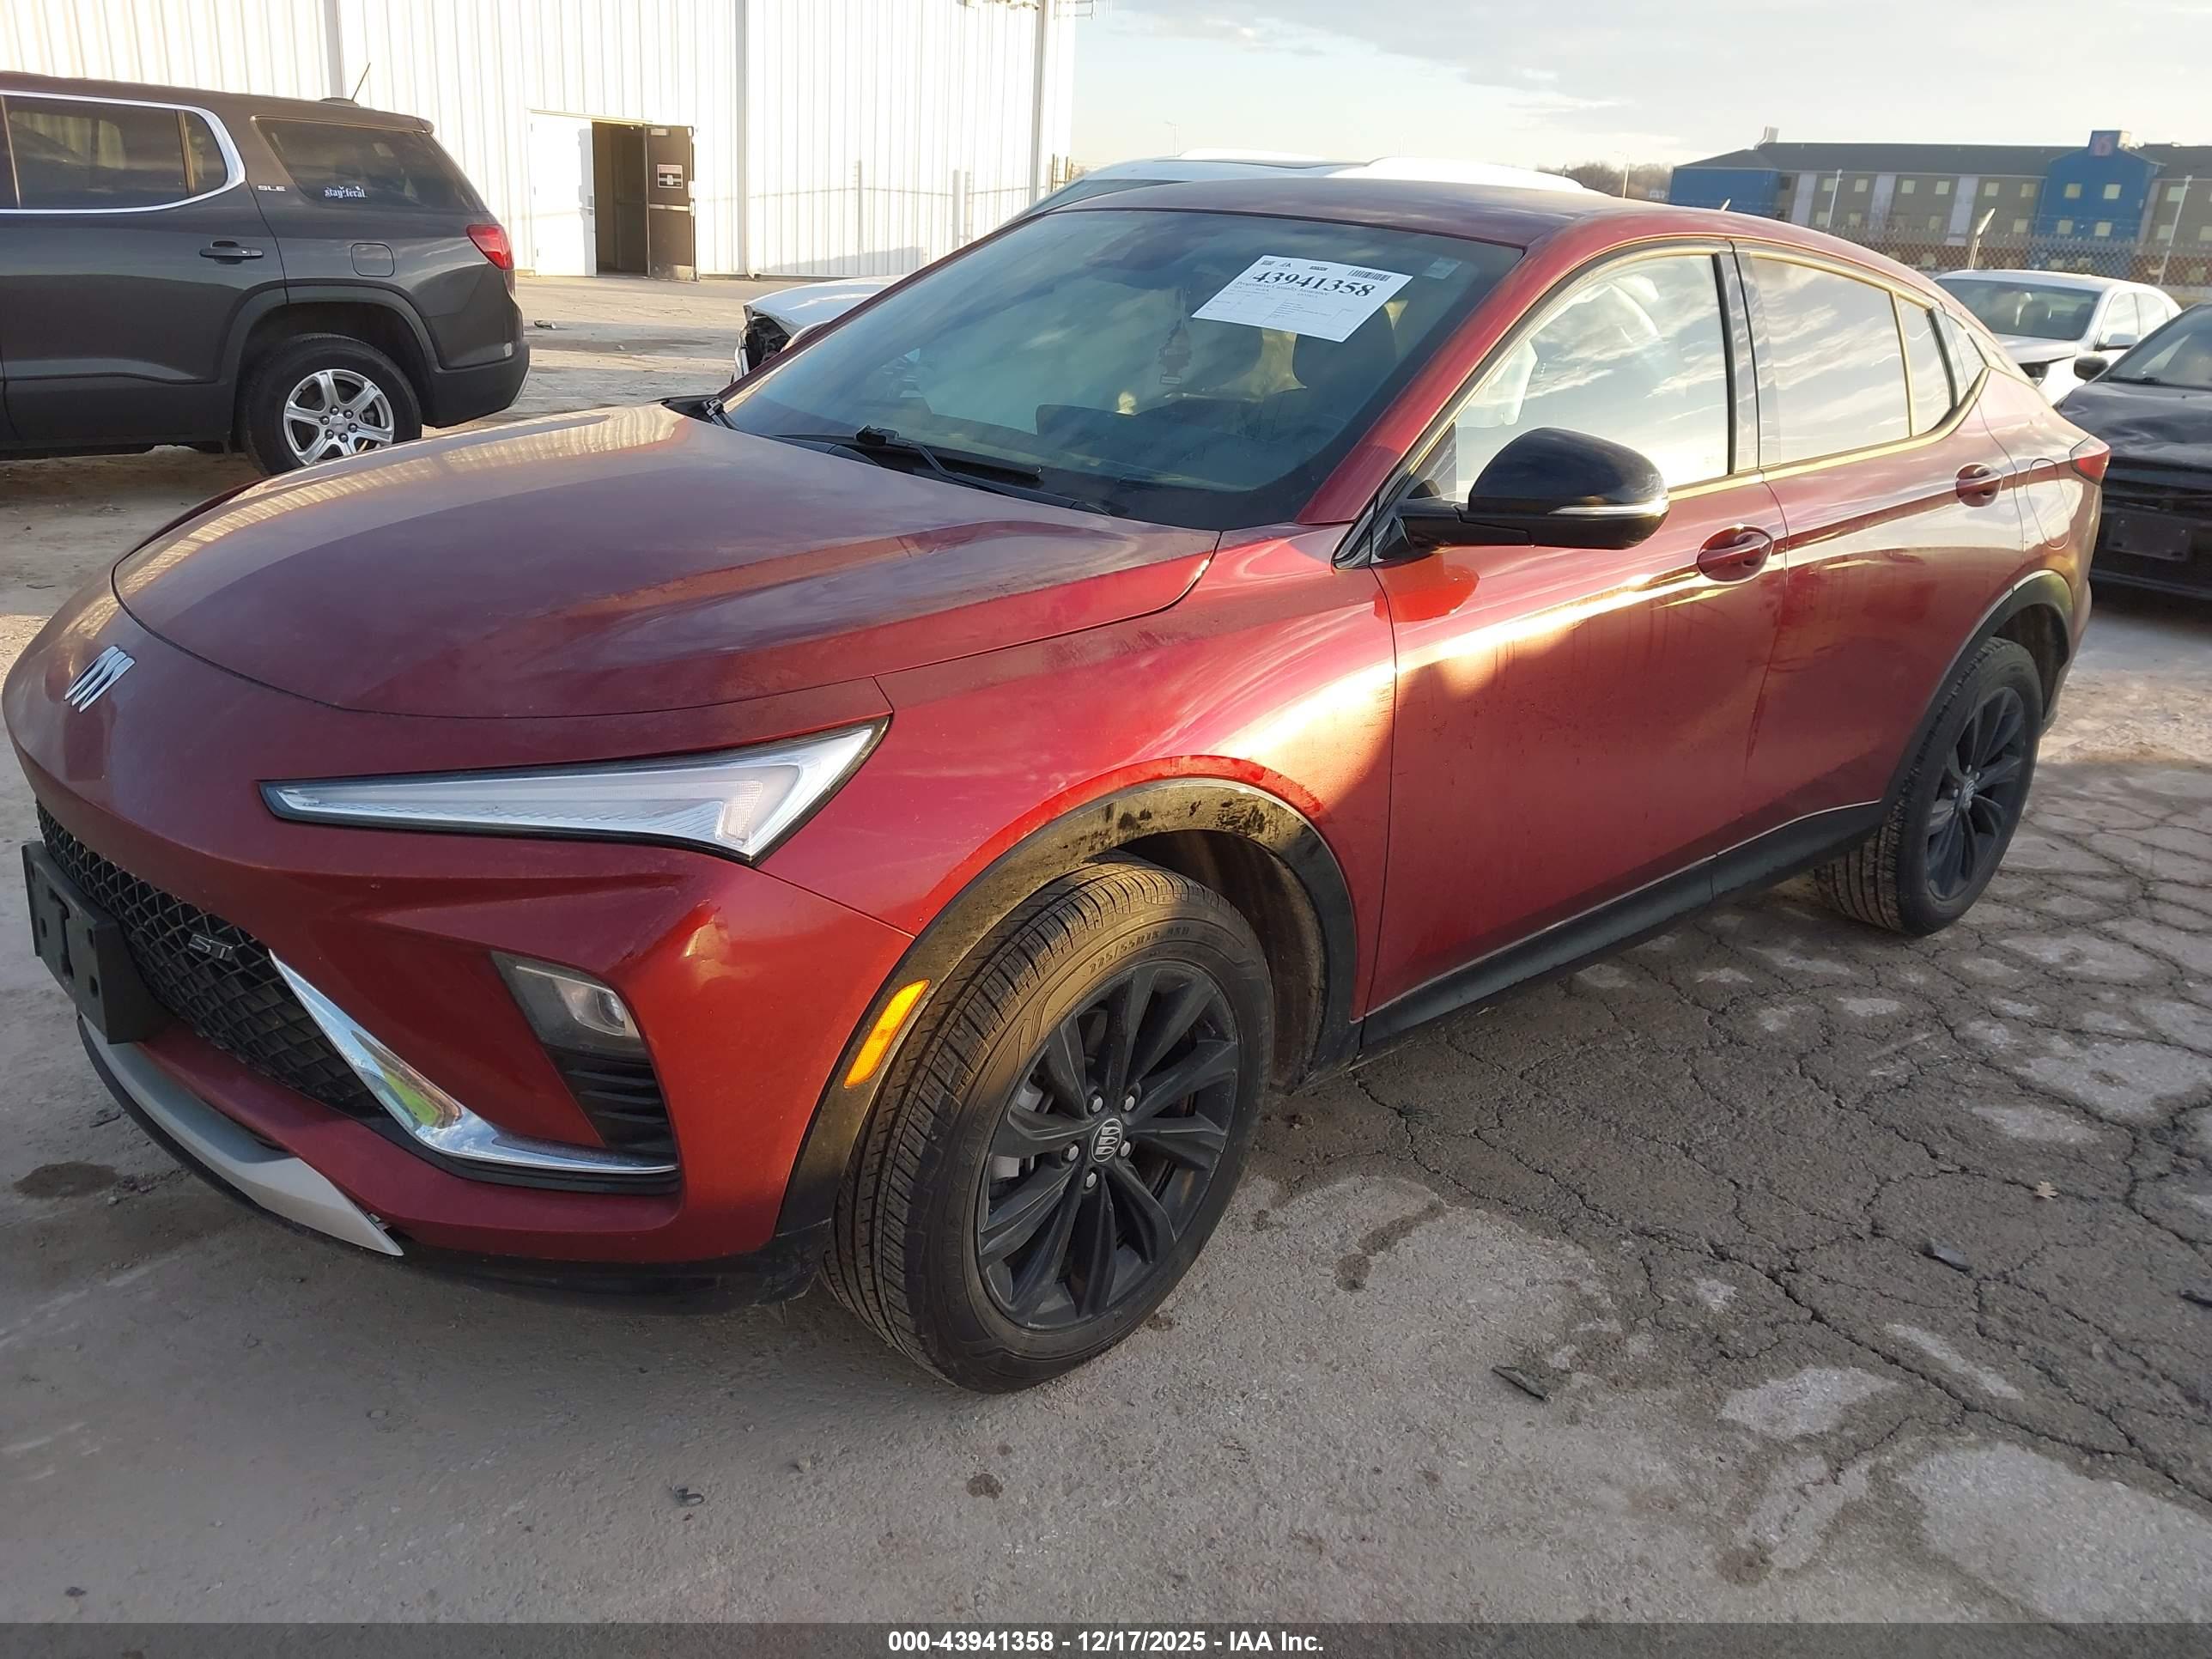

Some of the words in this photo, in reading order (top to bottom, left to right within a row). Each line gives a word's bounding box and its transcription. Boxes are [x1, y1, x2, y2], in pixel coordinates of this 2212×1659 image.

[2094, 135, 2112, 156] 6
[1252, 270, 1376, 297] 43941358
[188, 933, 234, 962] ST
